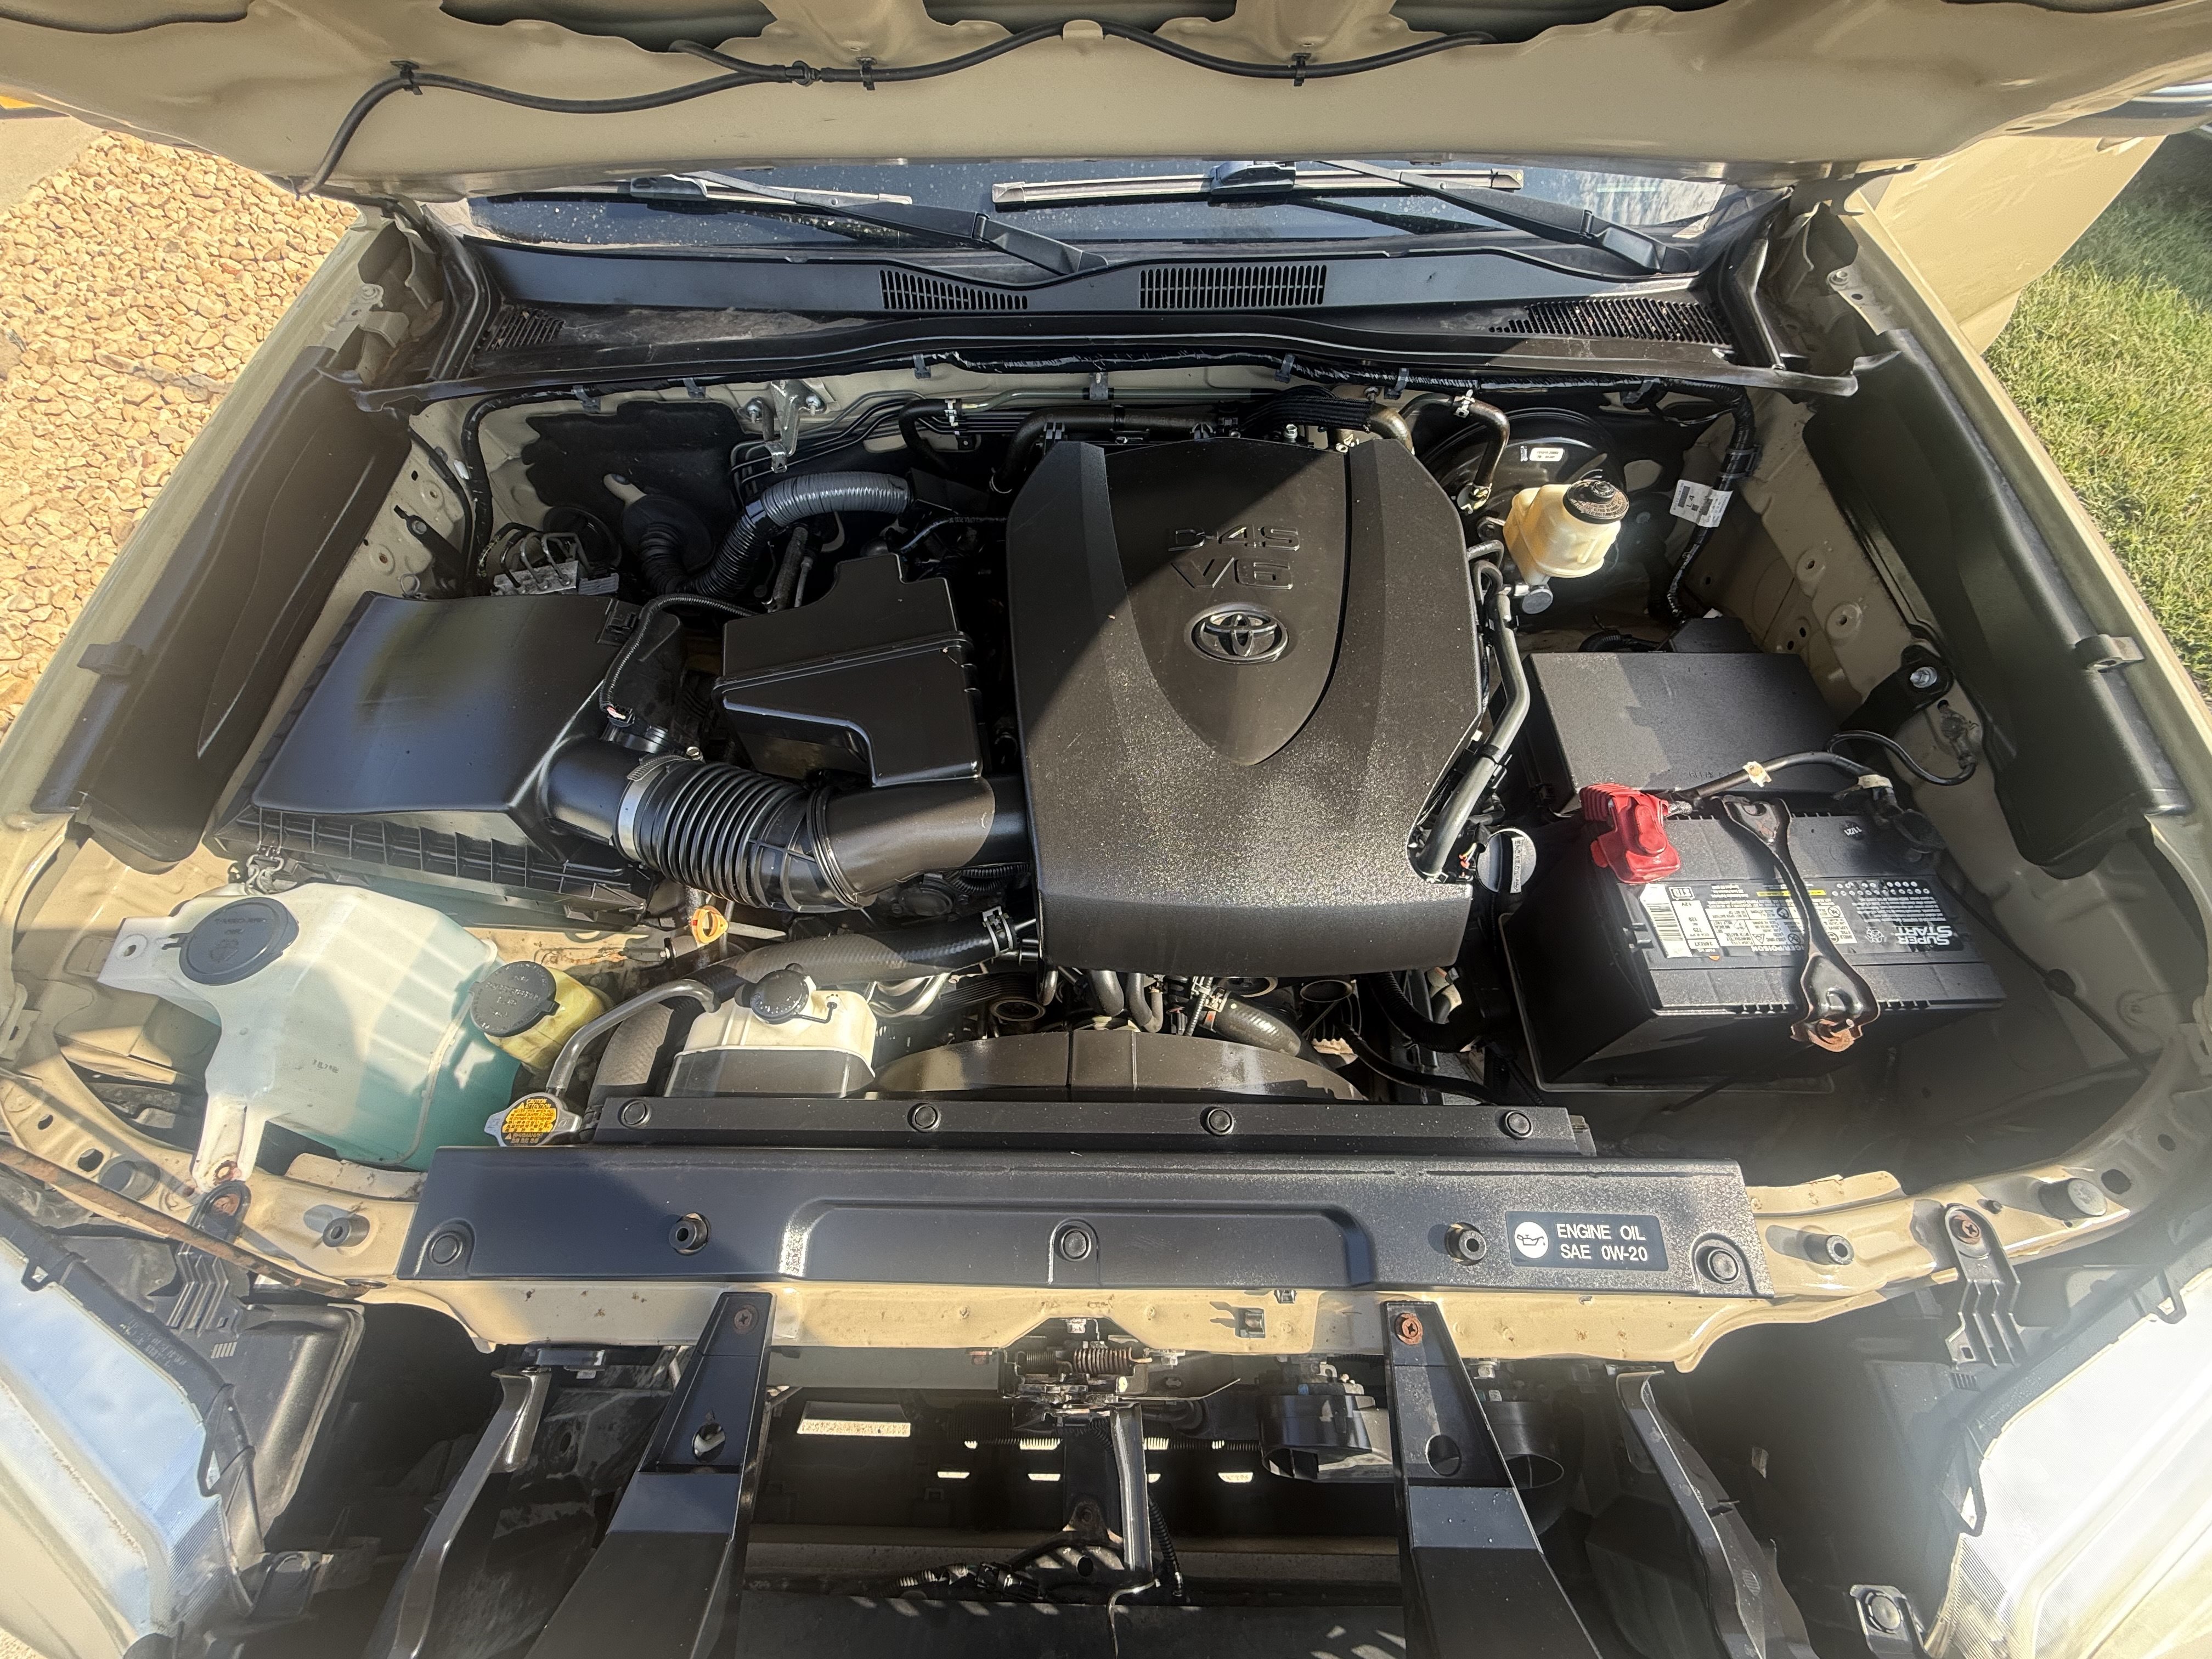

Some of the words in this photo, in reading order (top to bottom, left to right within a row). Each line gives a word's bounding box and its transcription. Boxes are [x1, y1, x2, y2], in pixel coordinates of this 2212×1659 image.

[1168, 524, 1301, 551] D-4S
[1170, 557, 1294, 590] V6
[1843, 826, 1863, 836] 11/21
[1894, 926, 1953, 937] START
[1898, 936, 1950, 945] SUPER
[1556, 1223, 1612, 1239] ENGINE
[1620, 1224, 1646, 1241] OIL
[1560, 1244, 1592, 1260] SAE
[1601, 1245, 1648, 1262] 0W-20
